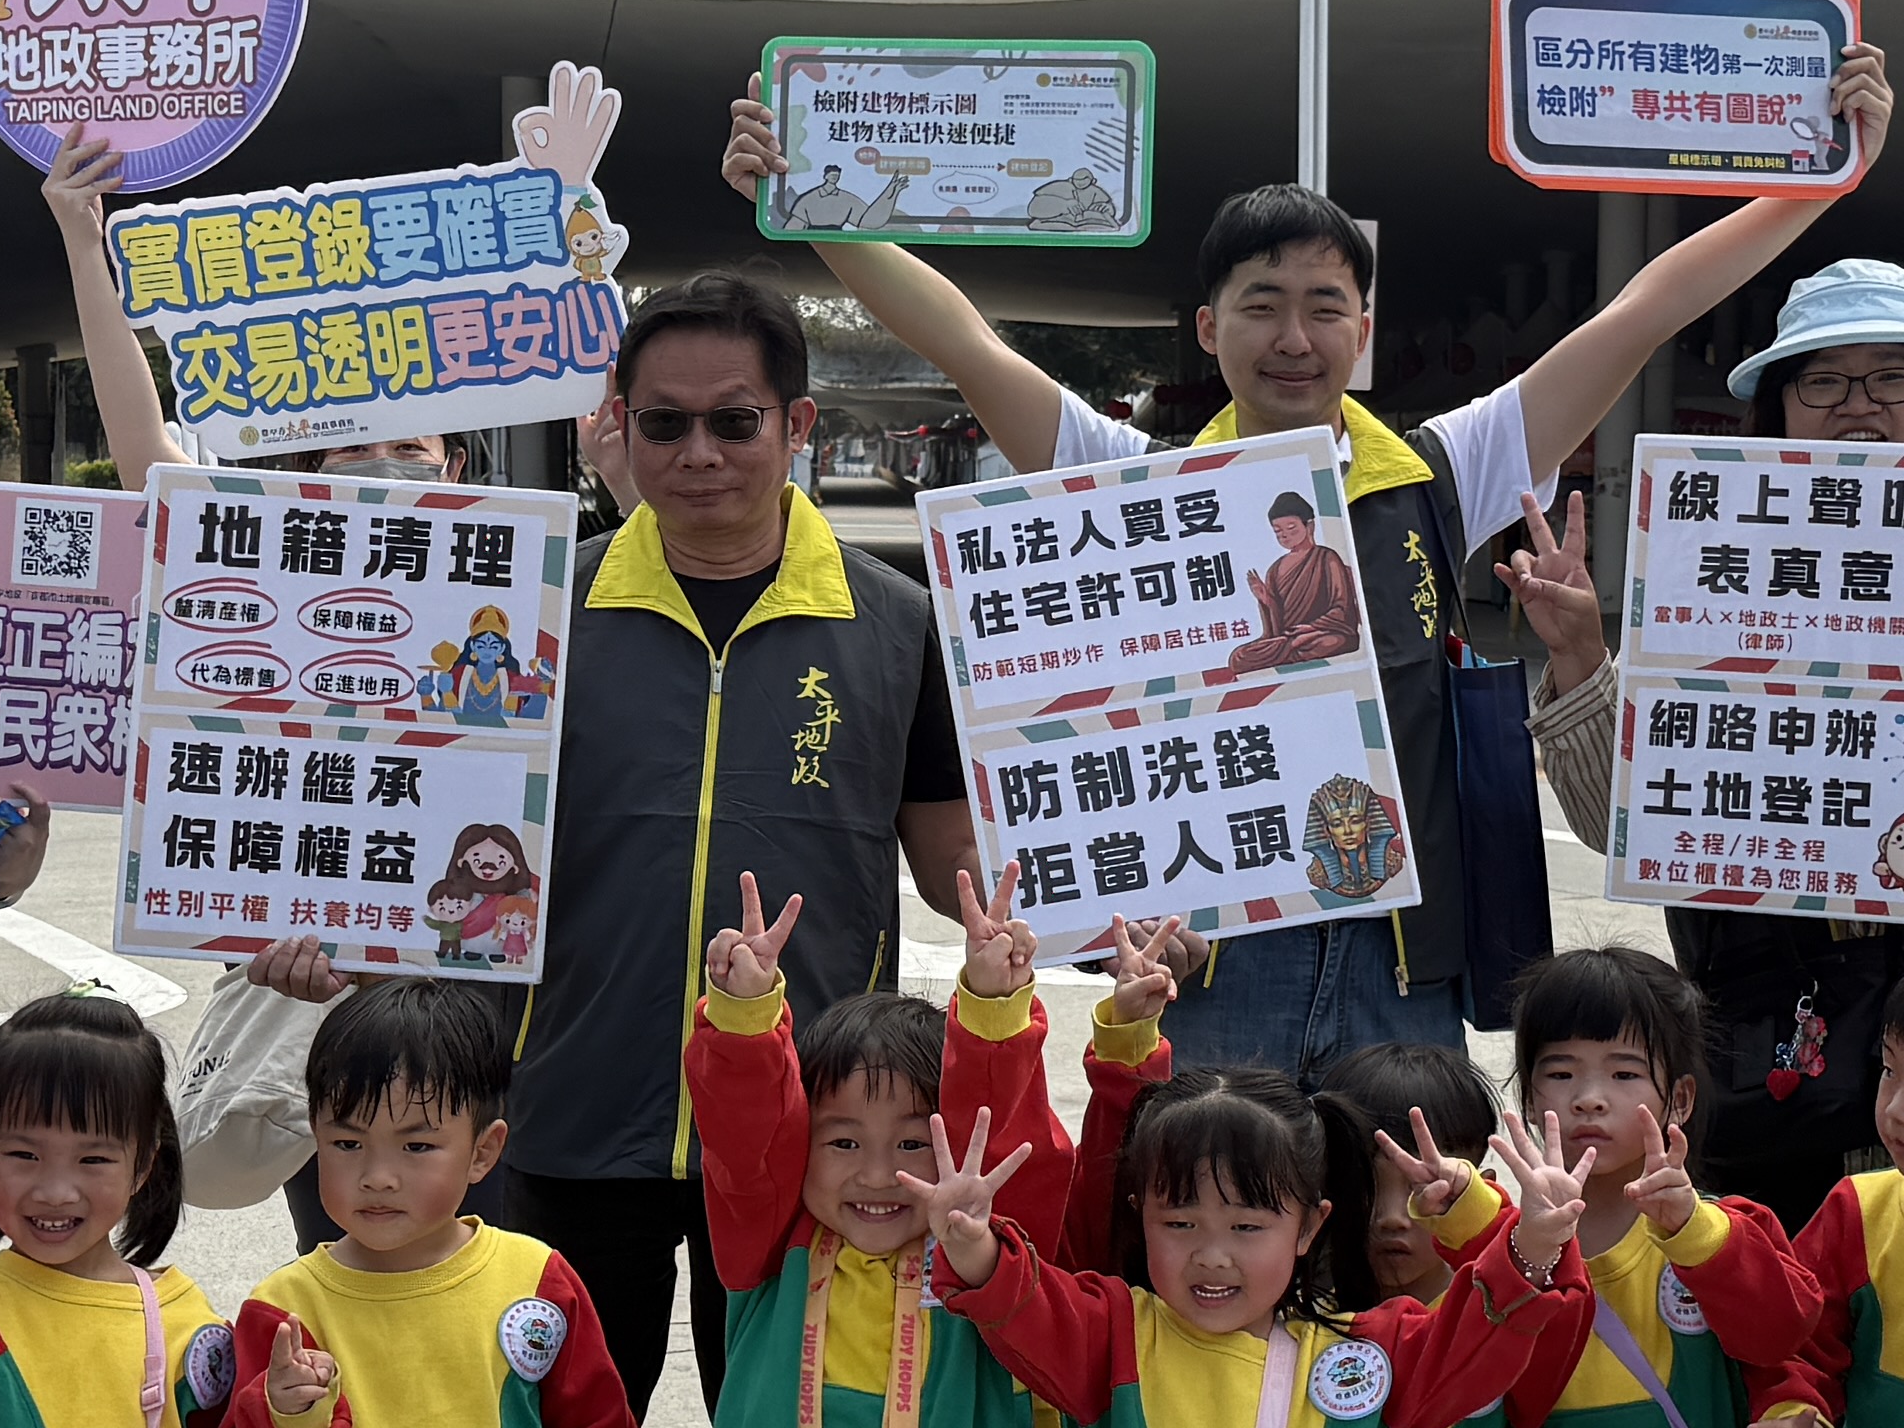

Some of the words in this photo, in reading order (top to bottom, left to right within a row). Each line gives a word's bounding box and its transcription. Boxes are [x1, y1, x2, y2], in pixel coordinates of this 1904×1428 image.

[4, 99, 90, 123] TAIPING
[97, 97, 157, 121] LAND
[162, 94, 245, 119] OFFICE
[813, 89, 977, 117] 檢附建物標示圖
[829, 120, 1017, 146] 建物登記快速便捷
[116, 173, 566, 315] 實價登錄要確實
[176, 280, 622, 424] 交易透明更安心
[197, 503, 516, 589] 地籍清理
[956, 489, 1226, 575] 私法人買受
[969, 551, 1236, 639] 住宅許可制
[1697, 544, 1894, 602] 表真意
[173, 598, 260, 625] 釐清產權
[312, 607, 398, 636] 保障權益
[1738, 631, 1793, 652] (律師)
[190, 662, 276, 689] 代為標售
[972, 642, 1105, 682] 防範短期炒作
[1119, 618, 1251, 657] 保障居住權益
[314, 671, 400, 698] 促進地用
[790, 665, 841, 789] 太平地政
[1648, 699, 1878, 759] 網路申辦
[169, 741, 423, 809] 速辦繼承
[998, 724, 1280, 827] 防制洗錢
[1643, 768, 1871, 828] 土地登記
[164, 814, 417, 884] 保障權益
[1016, 804, 1296, 910] 拒當人頭
[1673, 830, 1826, 863] 全程/非全程
[1638, 858, 1859, 896] 數位櫃檯為您服務
[144, 890, 269, 923] 性別平權
[290, 899, 415, 932] 扶養均等
